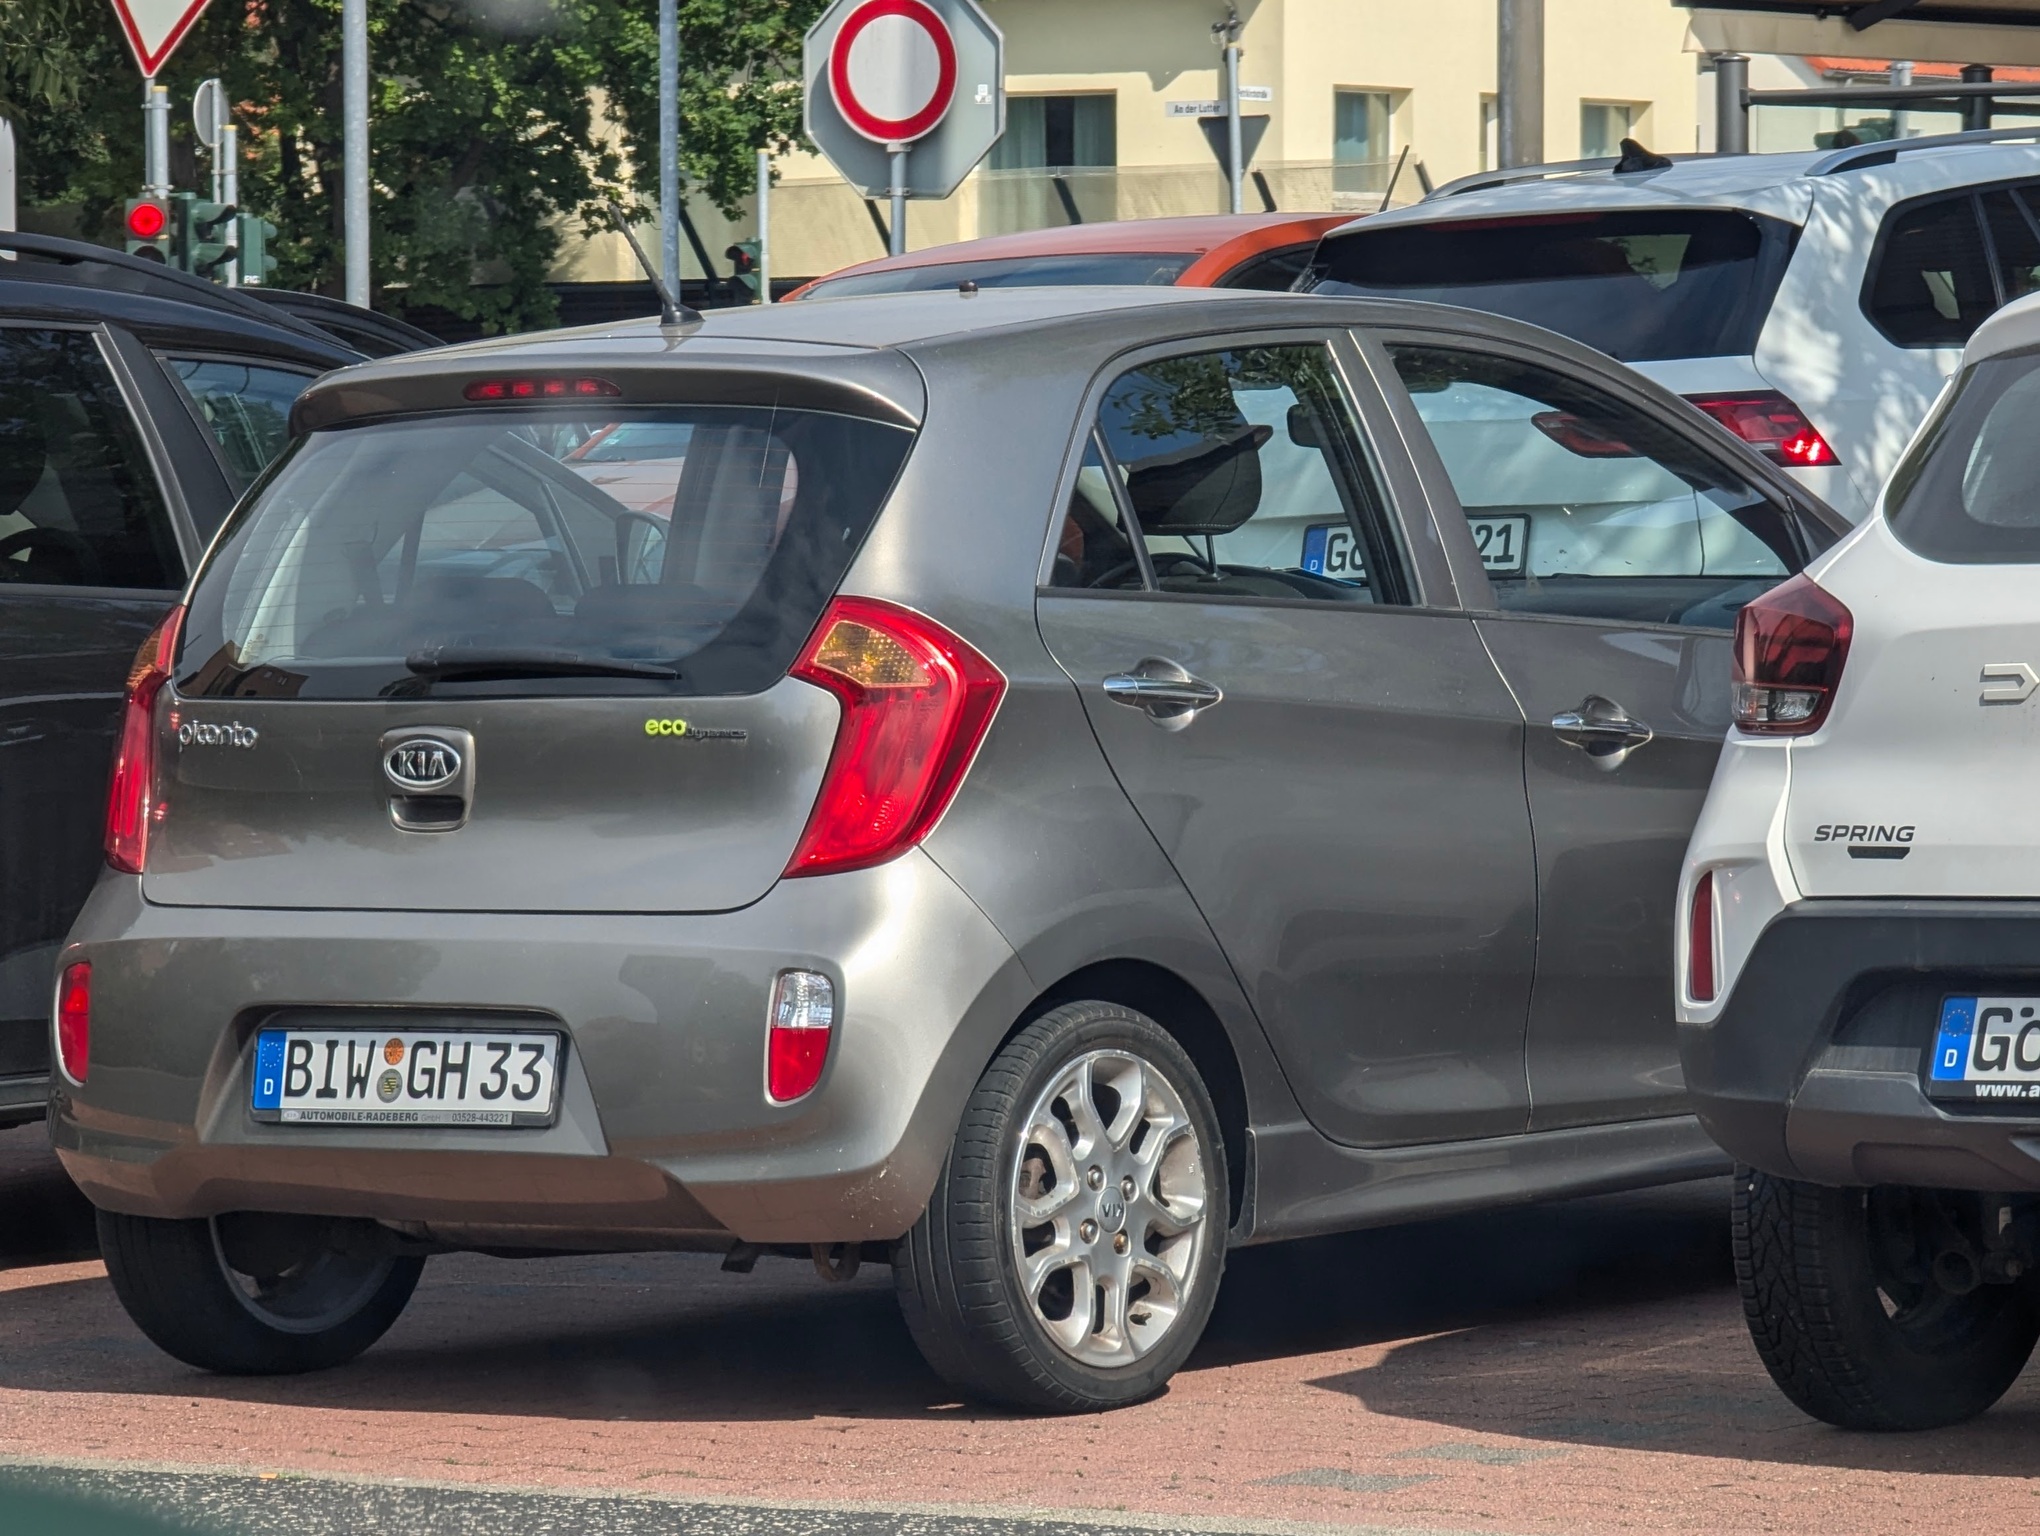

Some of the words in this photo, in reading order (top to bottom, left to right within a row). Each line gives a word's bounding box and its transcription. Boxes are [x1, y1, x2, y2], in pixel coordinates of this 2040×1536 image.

[1174, 105, 1184, 114] An
[1185, 104, 1197, 113] der
[1199, 104, 1221, 113] Lutter
[1310, 559, 1318, 571] D
[1470, 523, 1515, 564] 21
[179, 719, 258, 753] picanto
[399, 750, 448, 777] KIA
[1814, 825, 1916, 843] SPRING
[1944, 1048, 1958, 1068] D
[264, 1079, 273, 1095] D
[284, 1039, 376, 1099] BIW
[407, 1041, 472, 1101] GH
[480, 1042, 545, 1101] 33
[300, 1111, 419, 1122] AUTOMOBILE-RADEBERG
[452, 1113, 509, 1123] 03528-443221
